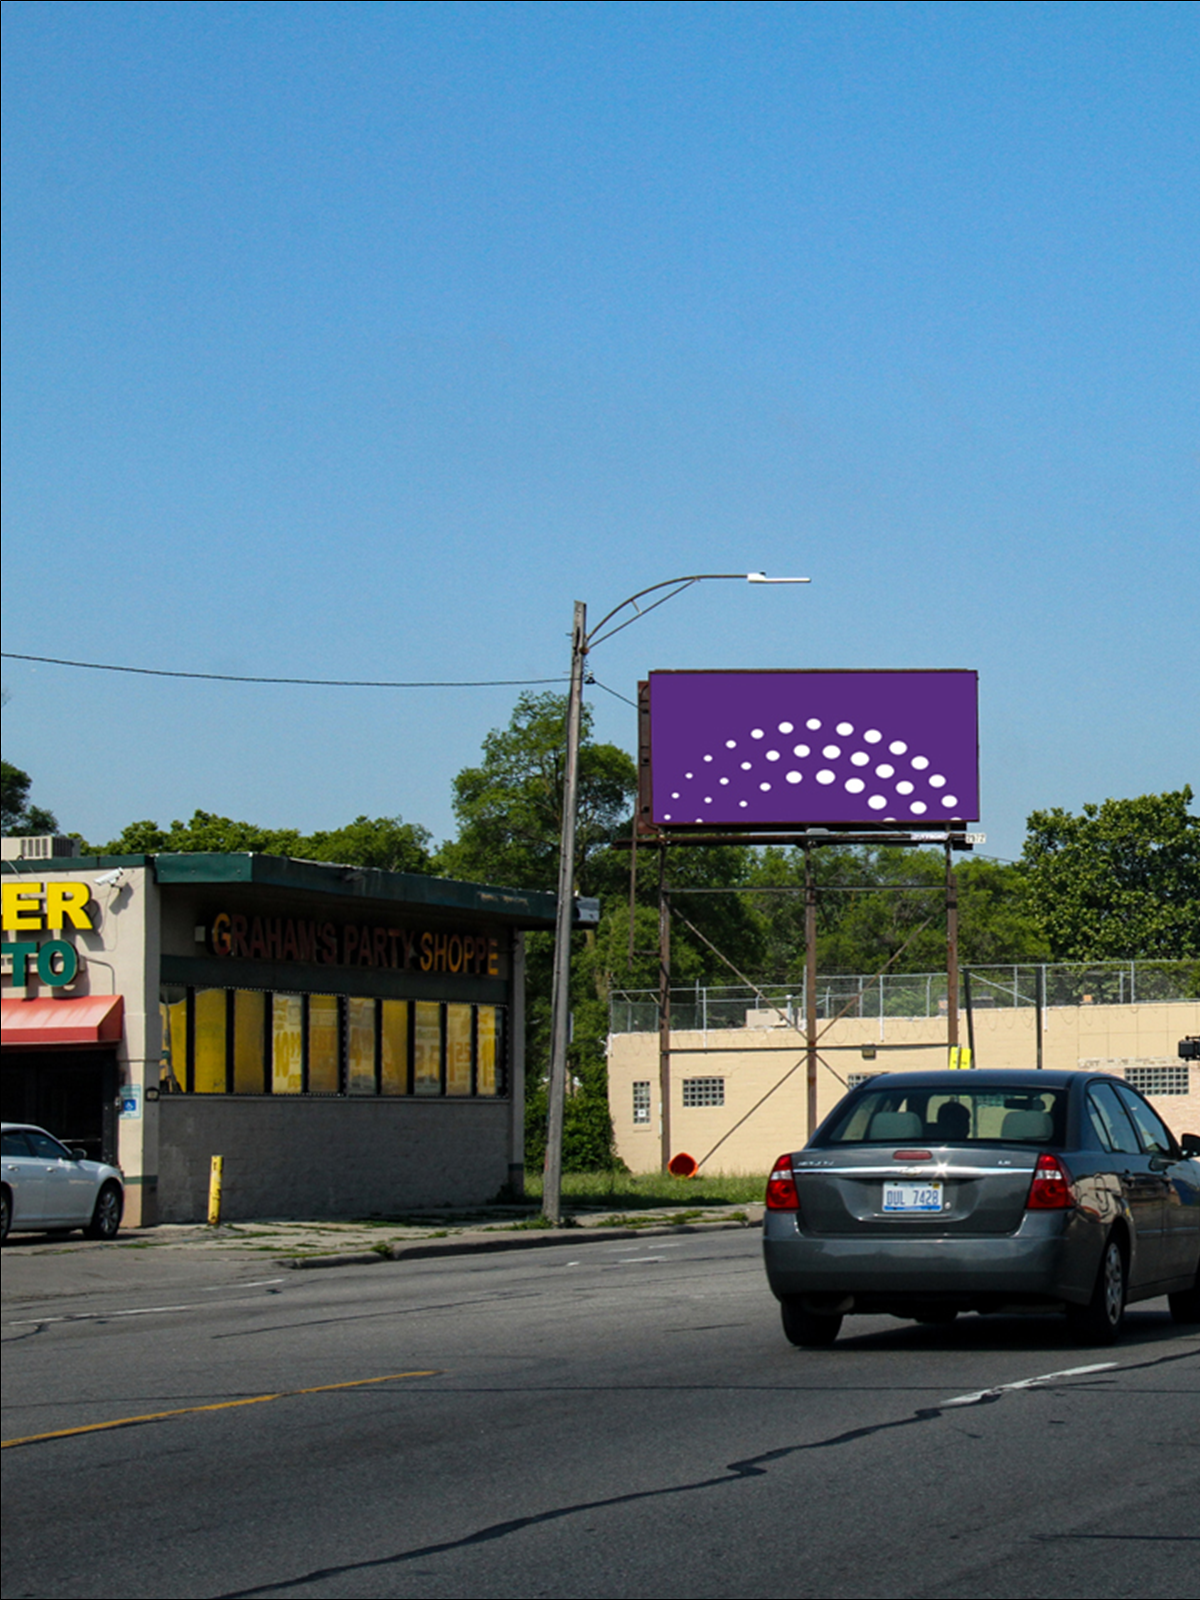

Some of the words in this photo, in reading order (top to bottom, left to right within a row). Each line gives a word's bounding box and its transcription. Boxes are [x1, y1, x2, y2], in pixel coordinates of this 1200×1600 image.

[2, 882, 93, 930] ER
[1, 940, 77, 987] TO
[212, 913, 337, 965] GRAHAM'S
[344, 924, 415, 969] PARTY
[420, 932, 498, 975] SHOPPE
[913, 1190, 939, 1205] 7428
